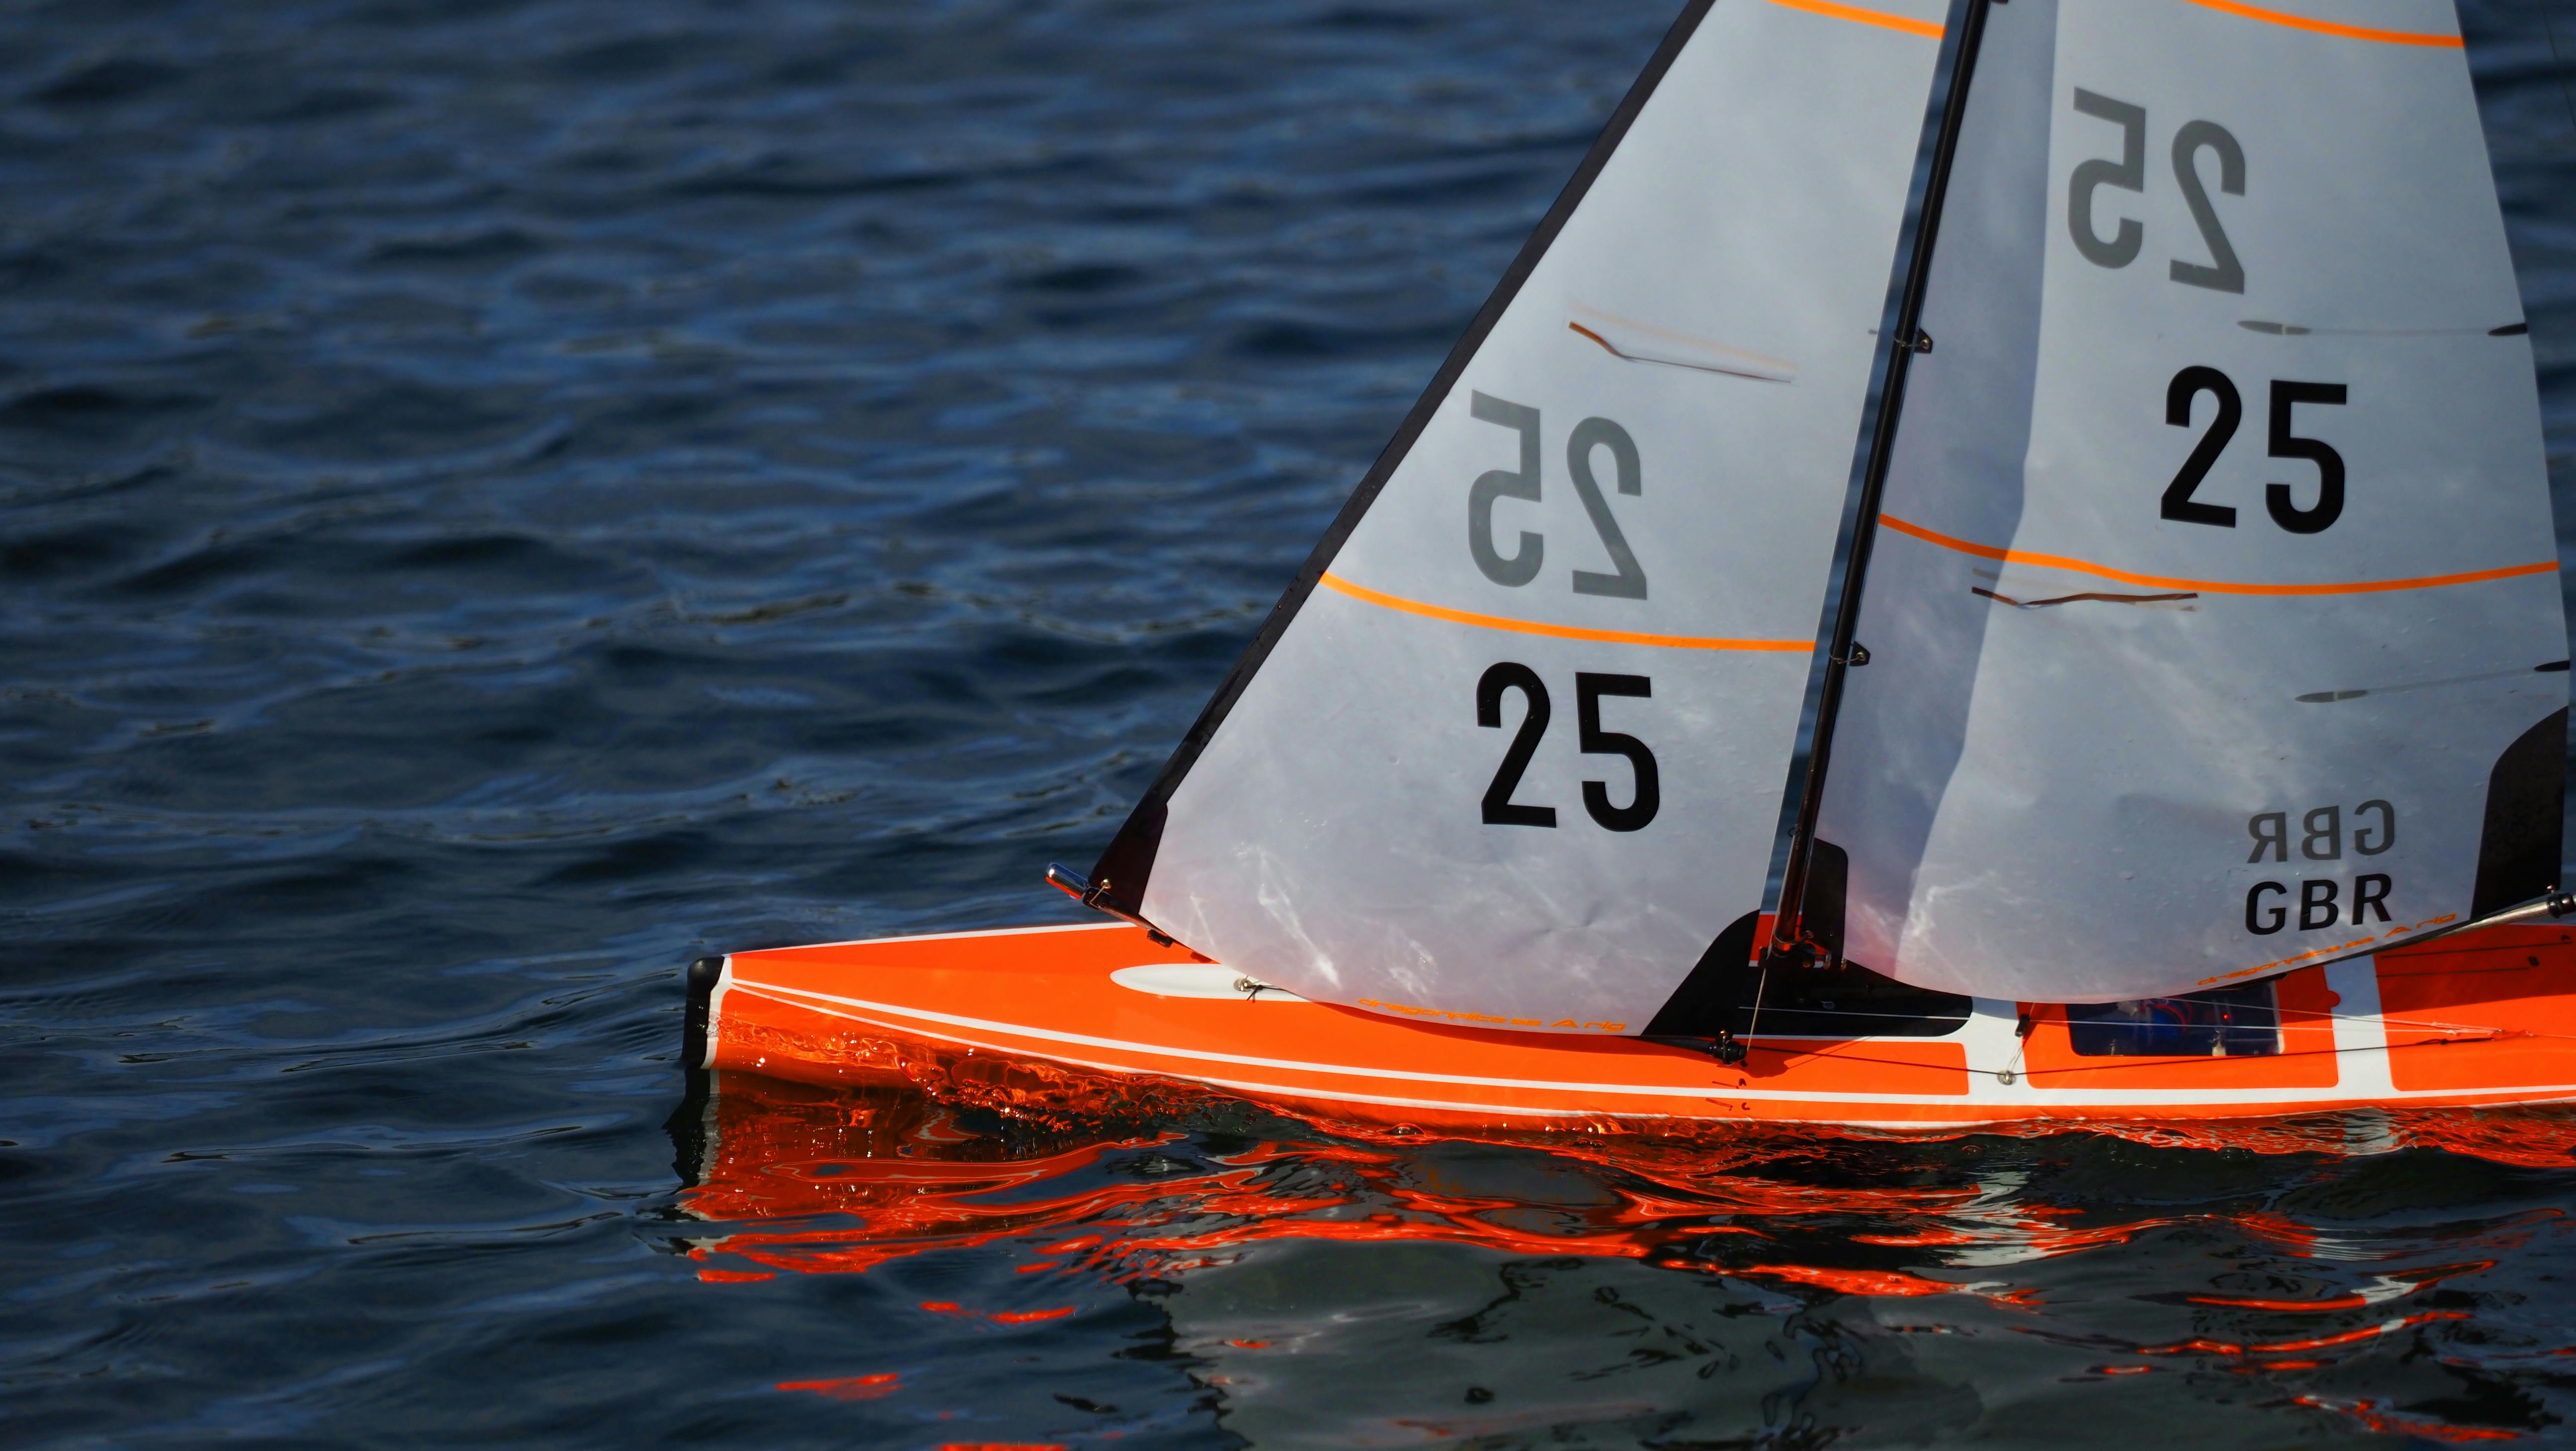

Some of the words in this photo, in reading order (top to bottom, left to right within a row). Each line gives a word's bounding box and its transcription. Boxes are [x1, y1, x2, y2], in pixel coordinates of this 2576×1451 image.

[2160, 365, 2347, 534] 25
[1476, 661, 1660, 832] 25
[2245, 873, 2392, 936] GBR
[1550, 1019, 1579, 1029] A
